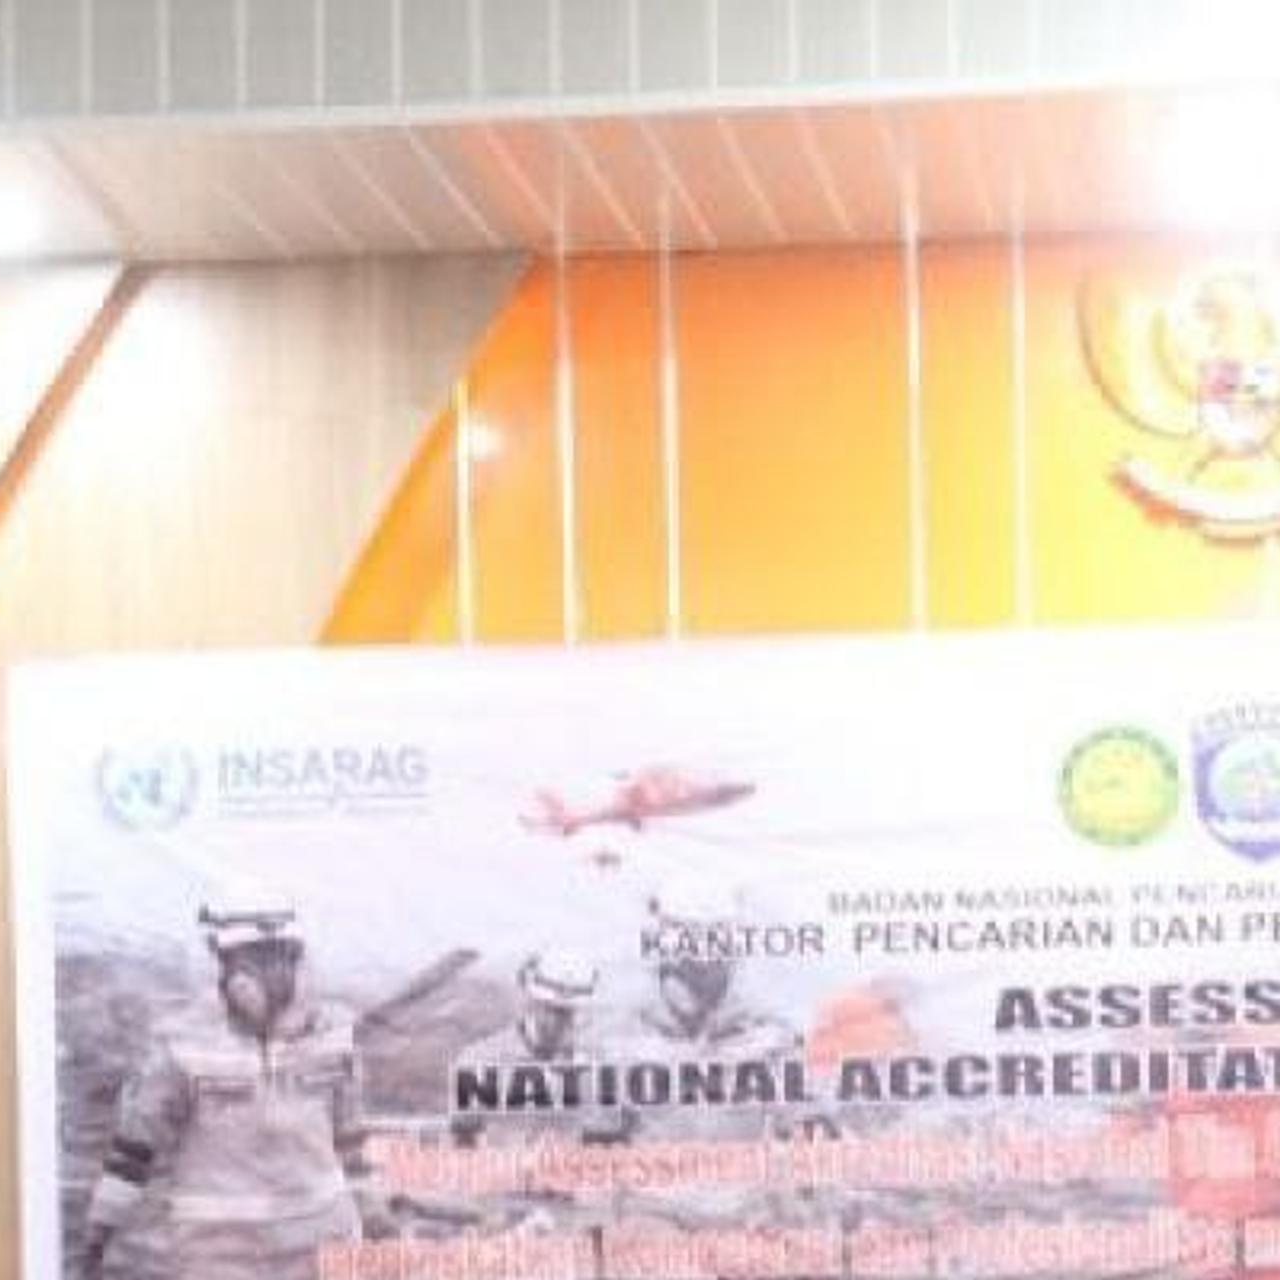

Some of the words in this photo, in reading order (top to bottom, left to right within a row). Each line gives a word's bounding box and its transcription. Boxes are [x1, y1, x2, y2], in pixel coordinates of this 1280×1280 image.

[218, 746, 428, 792] INSARAG
[828, 890, 944, 916] BADAN
[955, 885, 1113, 913] NASIONAL
[639, 922, 825, 957] KANTOR
[853, 917, 1114, 954] PENCARIAN
[1130, 912, 1226, 948] DAN
[455, 1059, 814, 1110] NATIONAL
